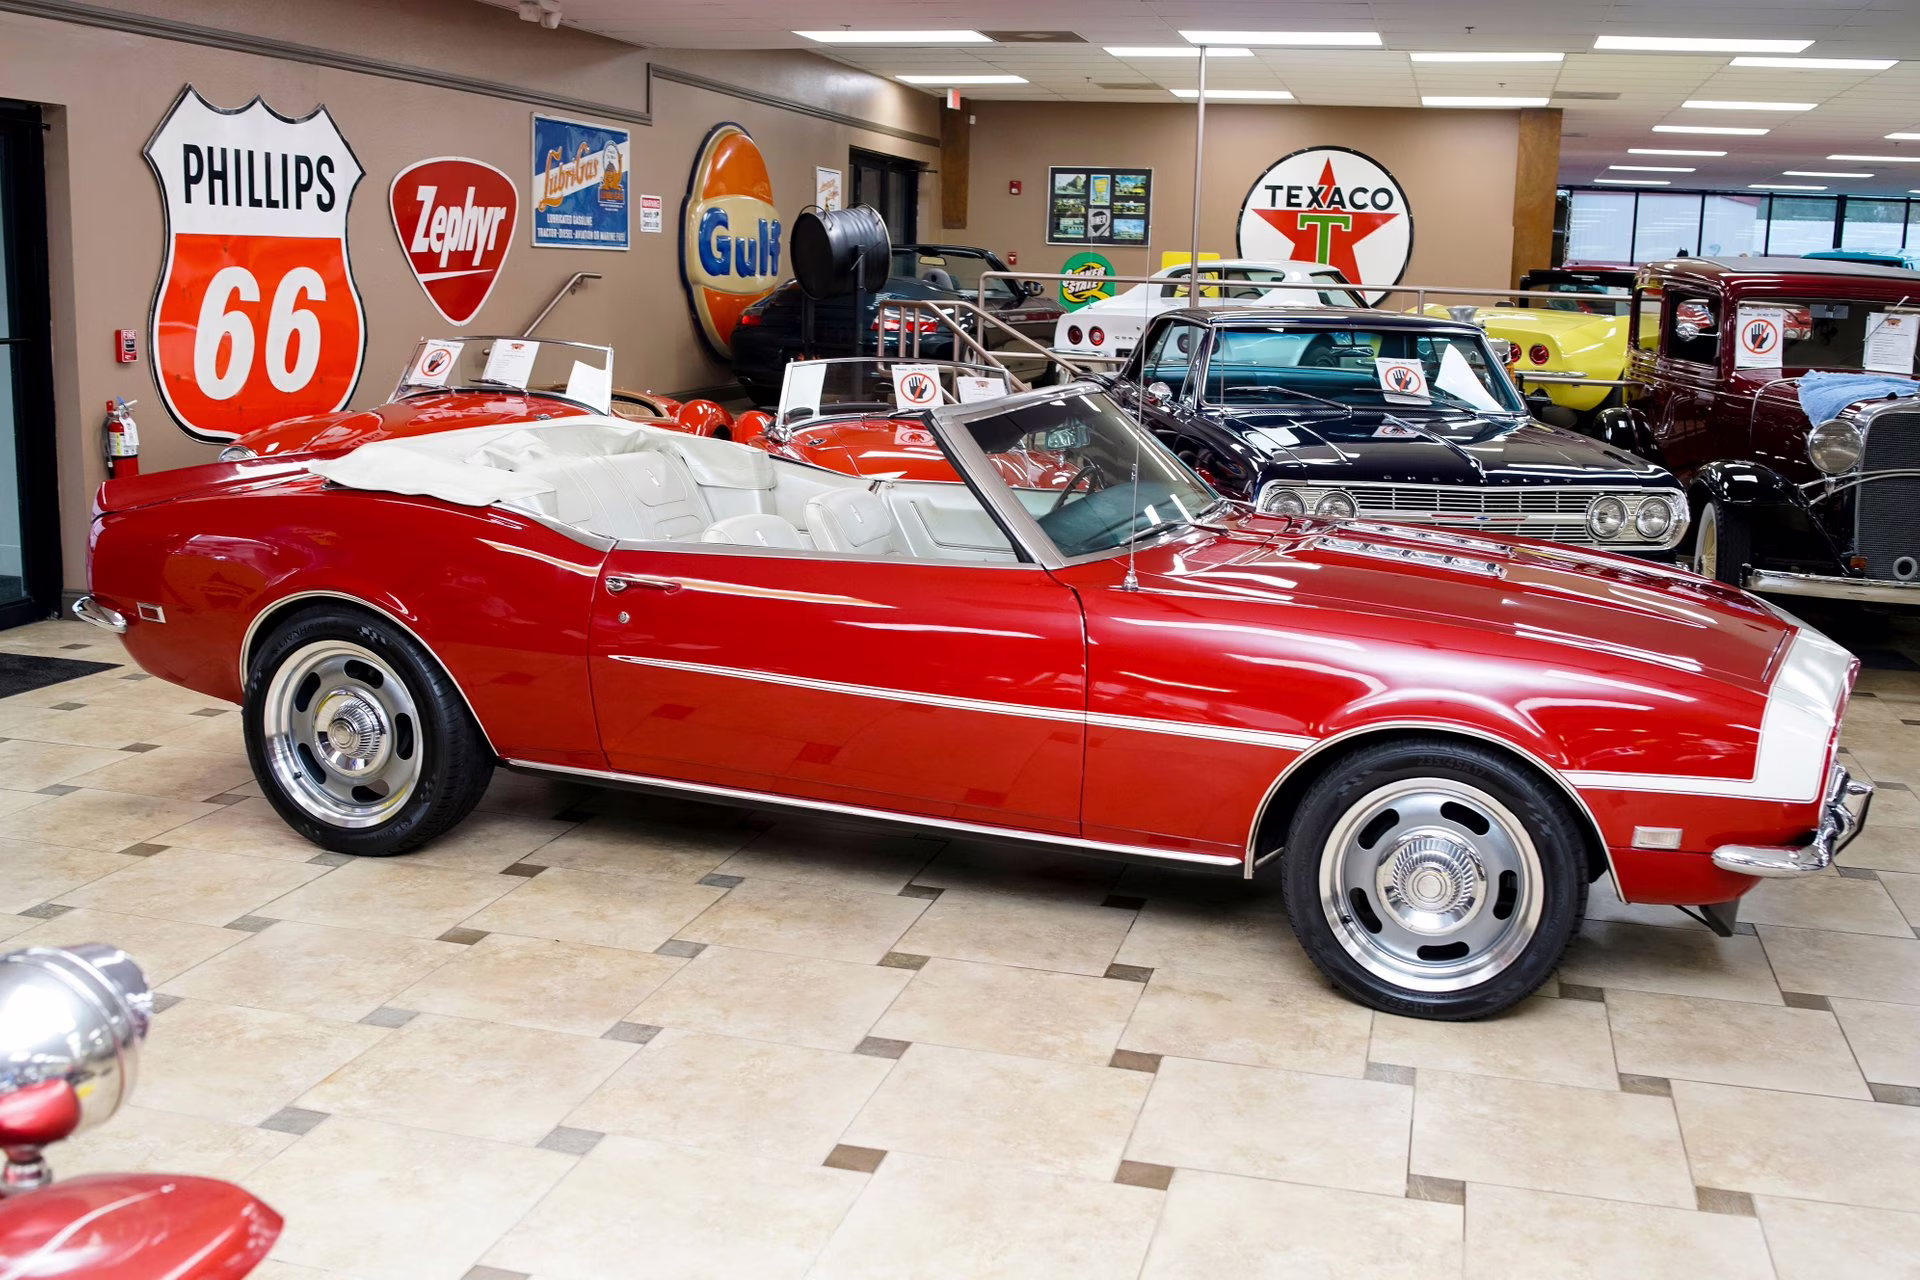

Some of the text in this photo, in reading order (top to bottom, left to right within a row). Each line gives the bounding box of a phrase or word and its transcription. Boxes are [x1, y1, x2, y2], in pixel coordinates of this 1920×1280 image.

[183, 143, 335, 212] PHILLIPS
[642, 199, 660, 208] WARNING
[1264, 185, 1394, 210] TEXACO
[410, 185, 507, 268] Zephyr
[547, 213, 592, 226] LUBRICATED GASOLINE
[698, 206, 781, 278] Gulf
[1297, 213, 1352, 265] T
[194, 266, 327, 400] 66
